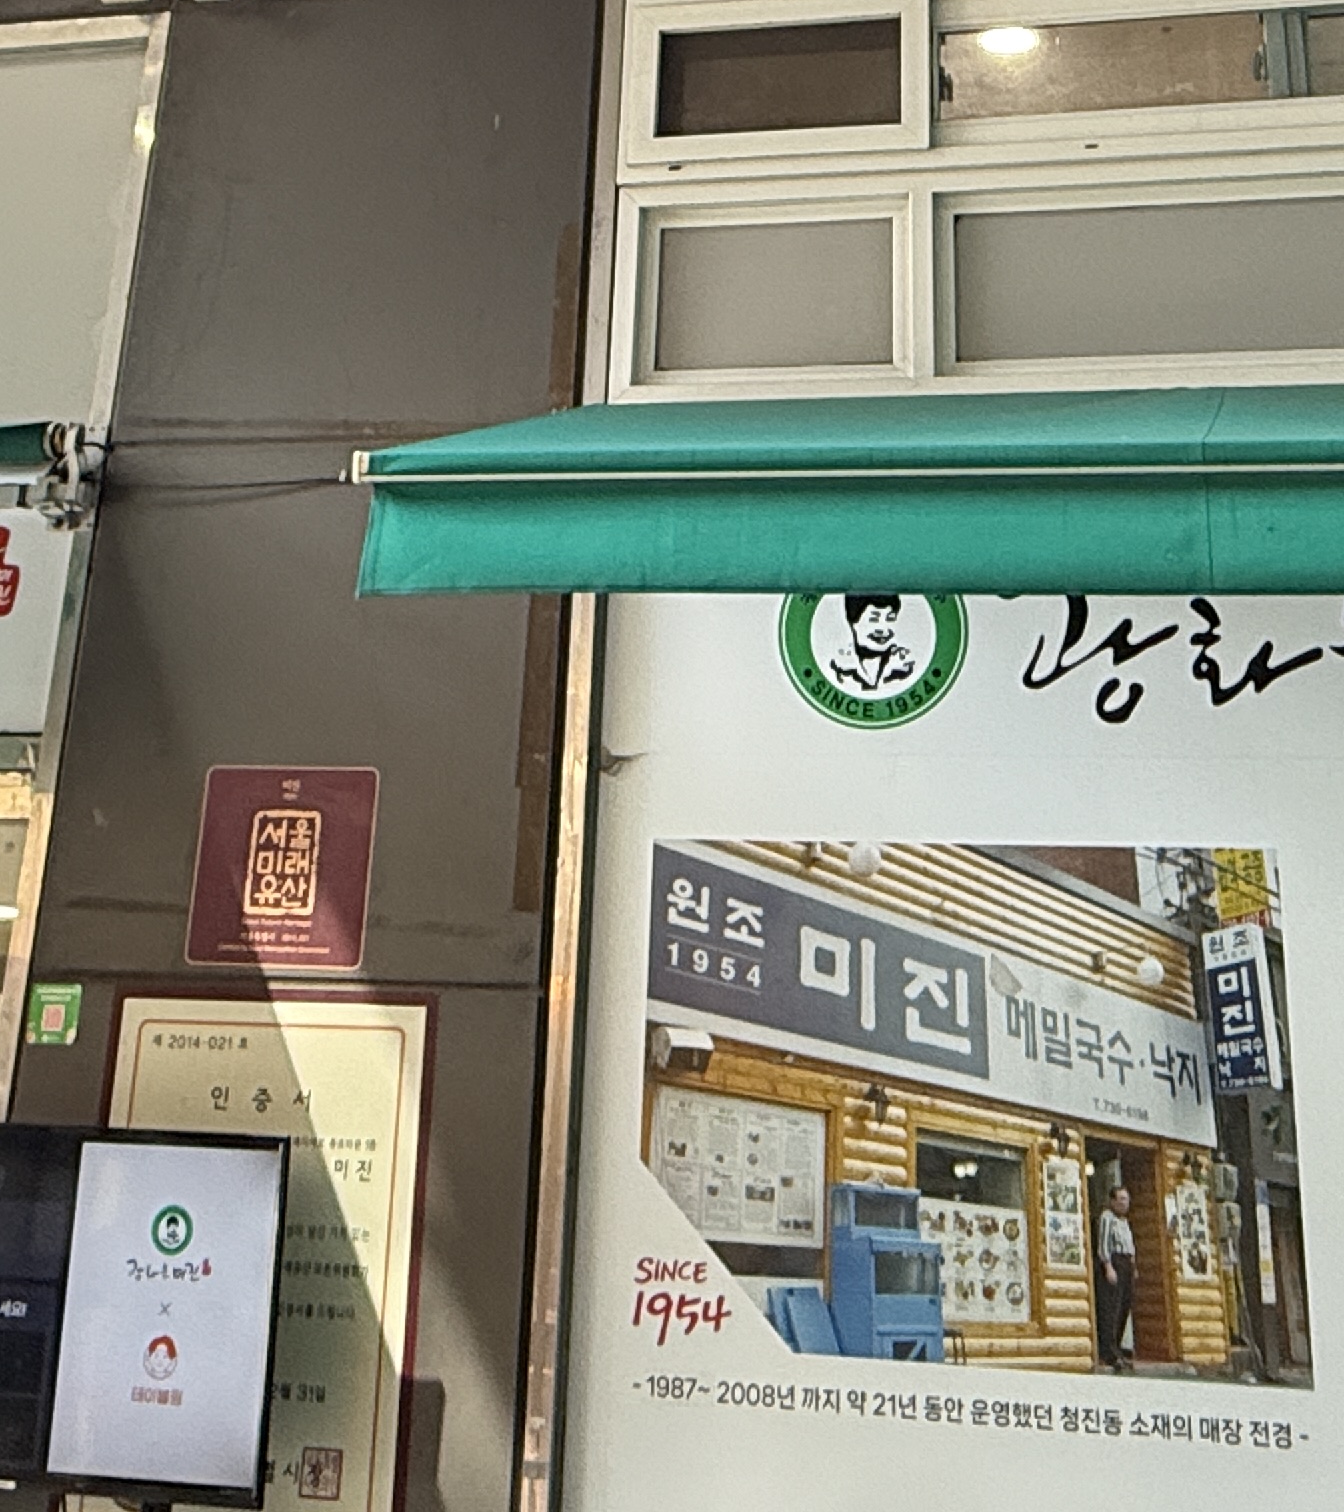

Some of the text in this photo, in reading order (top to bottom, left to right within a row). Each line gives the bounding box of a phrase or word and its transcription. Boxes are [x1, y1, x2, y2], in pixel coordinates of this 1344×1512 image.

[811, 680, 936, 718] SINCE 1954
[258, 818, 312, 850] 서울
[256, 850, 310, 875] 미래
[253, 875, 308, 908] 유산
[666, 878, 765, 948] 원조
[666, 941, 761, 988] 1954
[800, 925, 972, 1055] 미진
[634, 1256, 708, 1285] SINCE
[632, 1290, 733, 1347] 1954
[716, 1379, 796, 1410] 2008년
[801, 1386, 841, 1414] 까지
[846, 1388, 867, 1417] 약
[872, 1392, 918, 1420] 21년
[923, 1394, 964, 1423] 동안
[970, 1398, 1054, 1431] 운영했던
[1060, 1406, 1123, 1437] 청진동
[1129, 1412, 1194, 1442] 소재의
[1199, 1416, 1243, 1445] 매장
[1248, 1420, 1293, 1450] 전경
